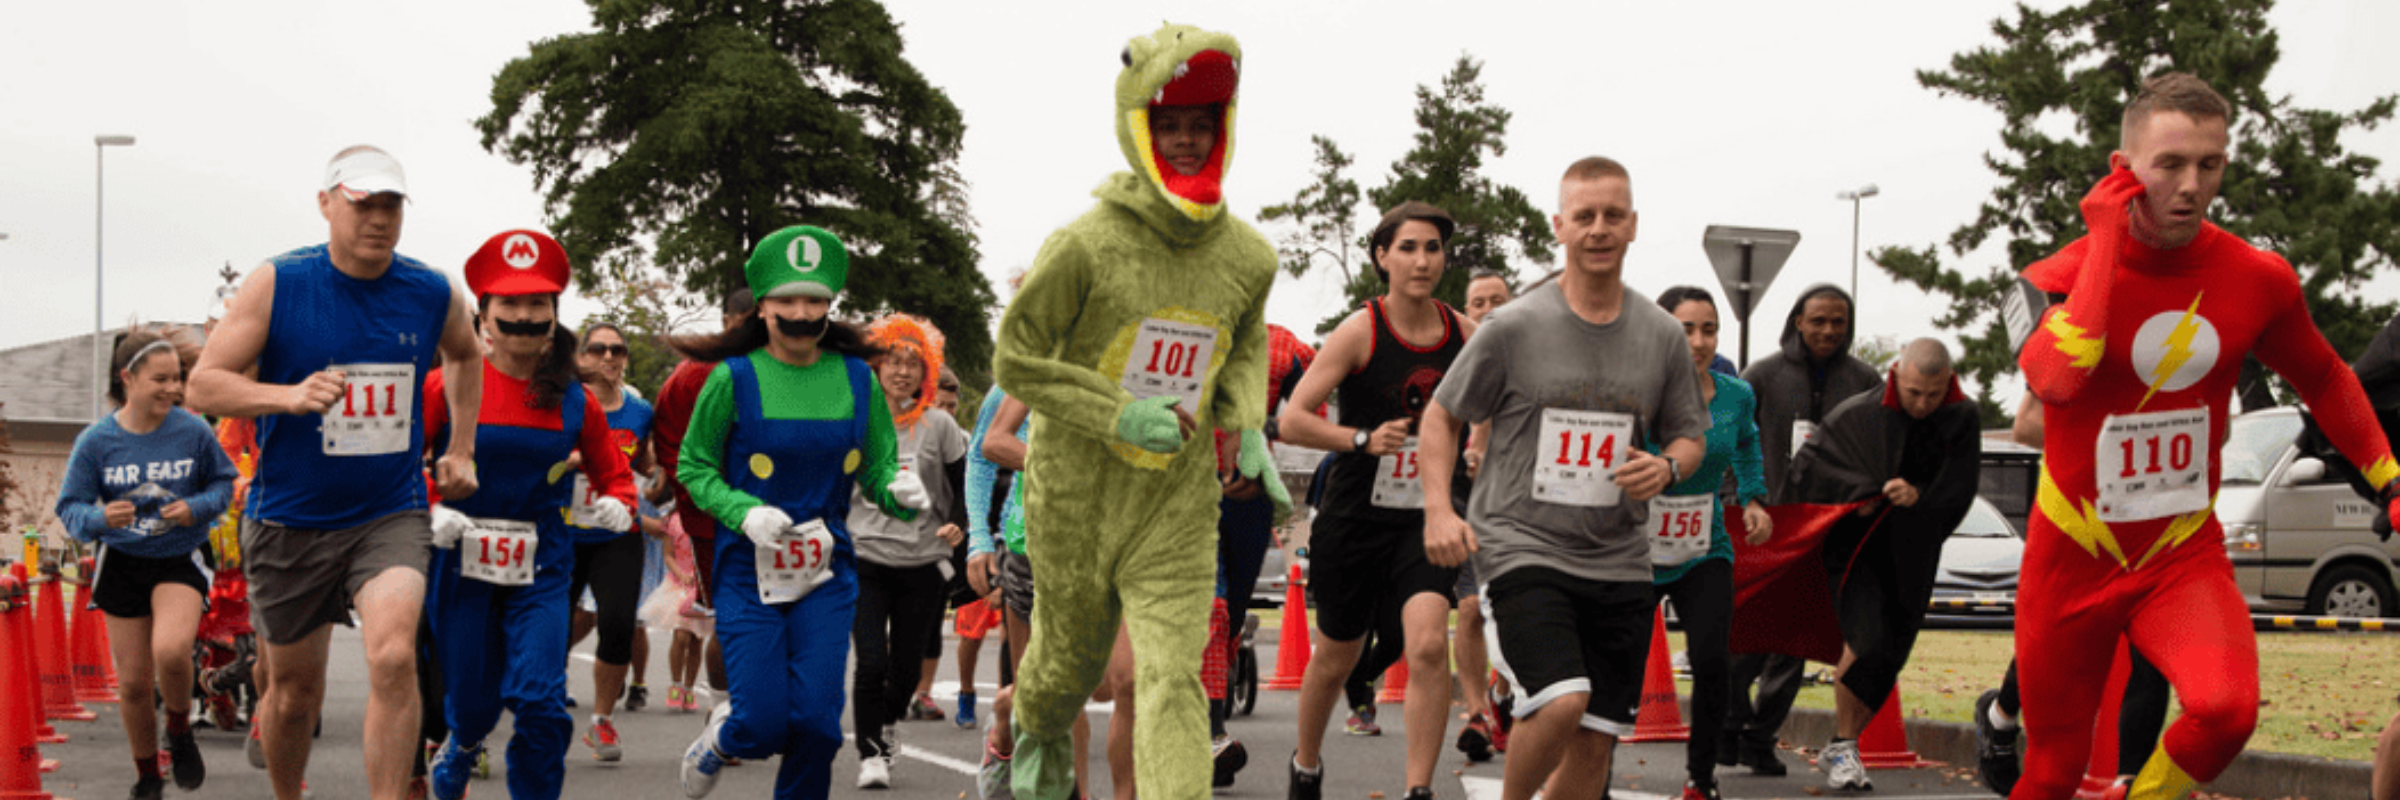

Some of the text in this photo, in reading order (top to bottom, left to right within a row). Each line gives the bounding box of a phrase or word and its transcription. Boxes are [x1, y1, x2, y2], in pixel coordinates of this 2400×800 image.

[506, 240, 535, 259] M
[796, 240, 813, 267] L
[1145, 338, 1199, 379] 101
[342, 382, 397, 417] 111
[1555, 430, 1615, 469] 114
[2119, 433, 2193, 478] 110
[104, 458, 194, 485] FAR EAST
[1657, 510, 1703, 538] 156
[479, 536, 525, 568] 154
[773, 537, 822, 570] 153
